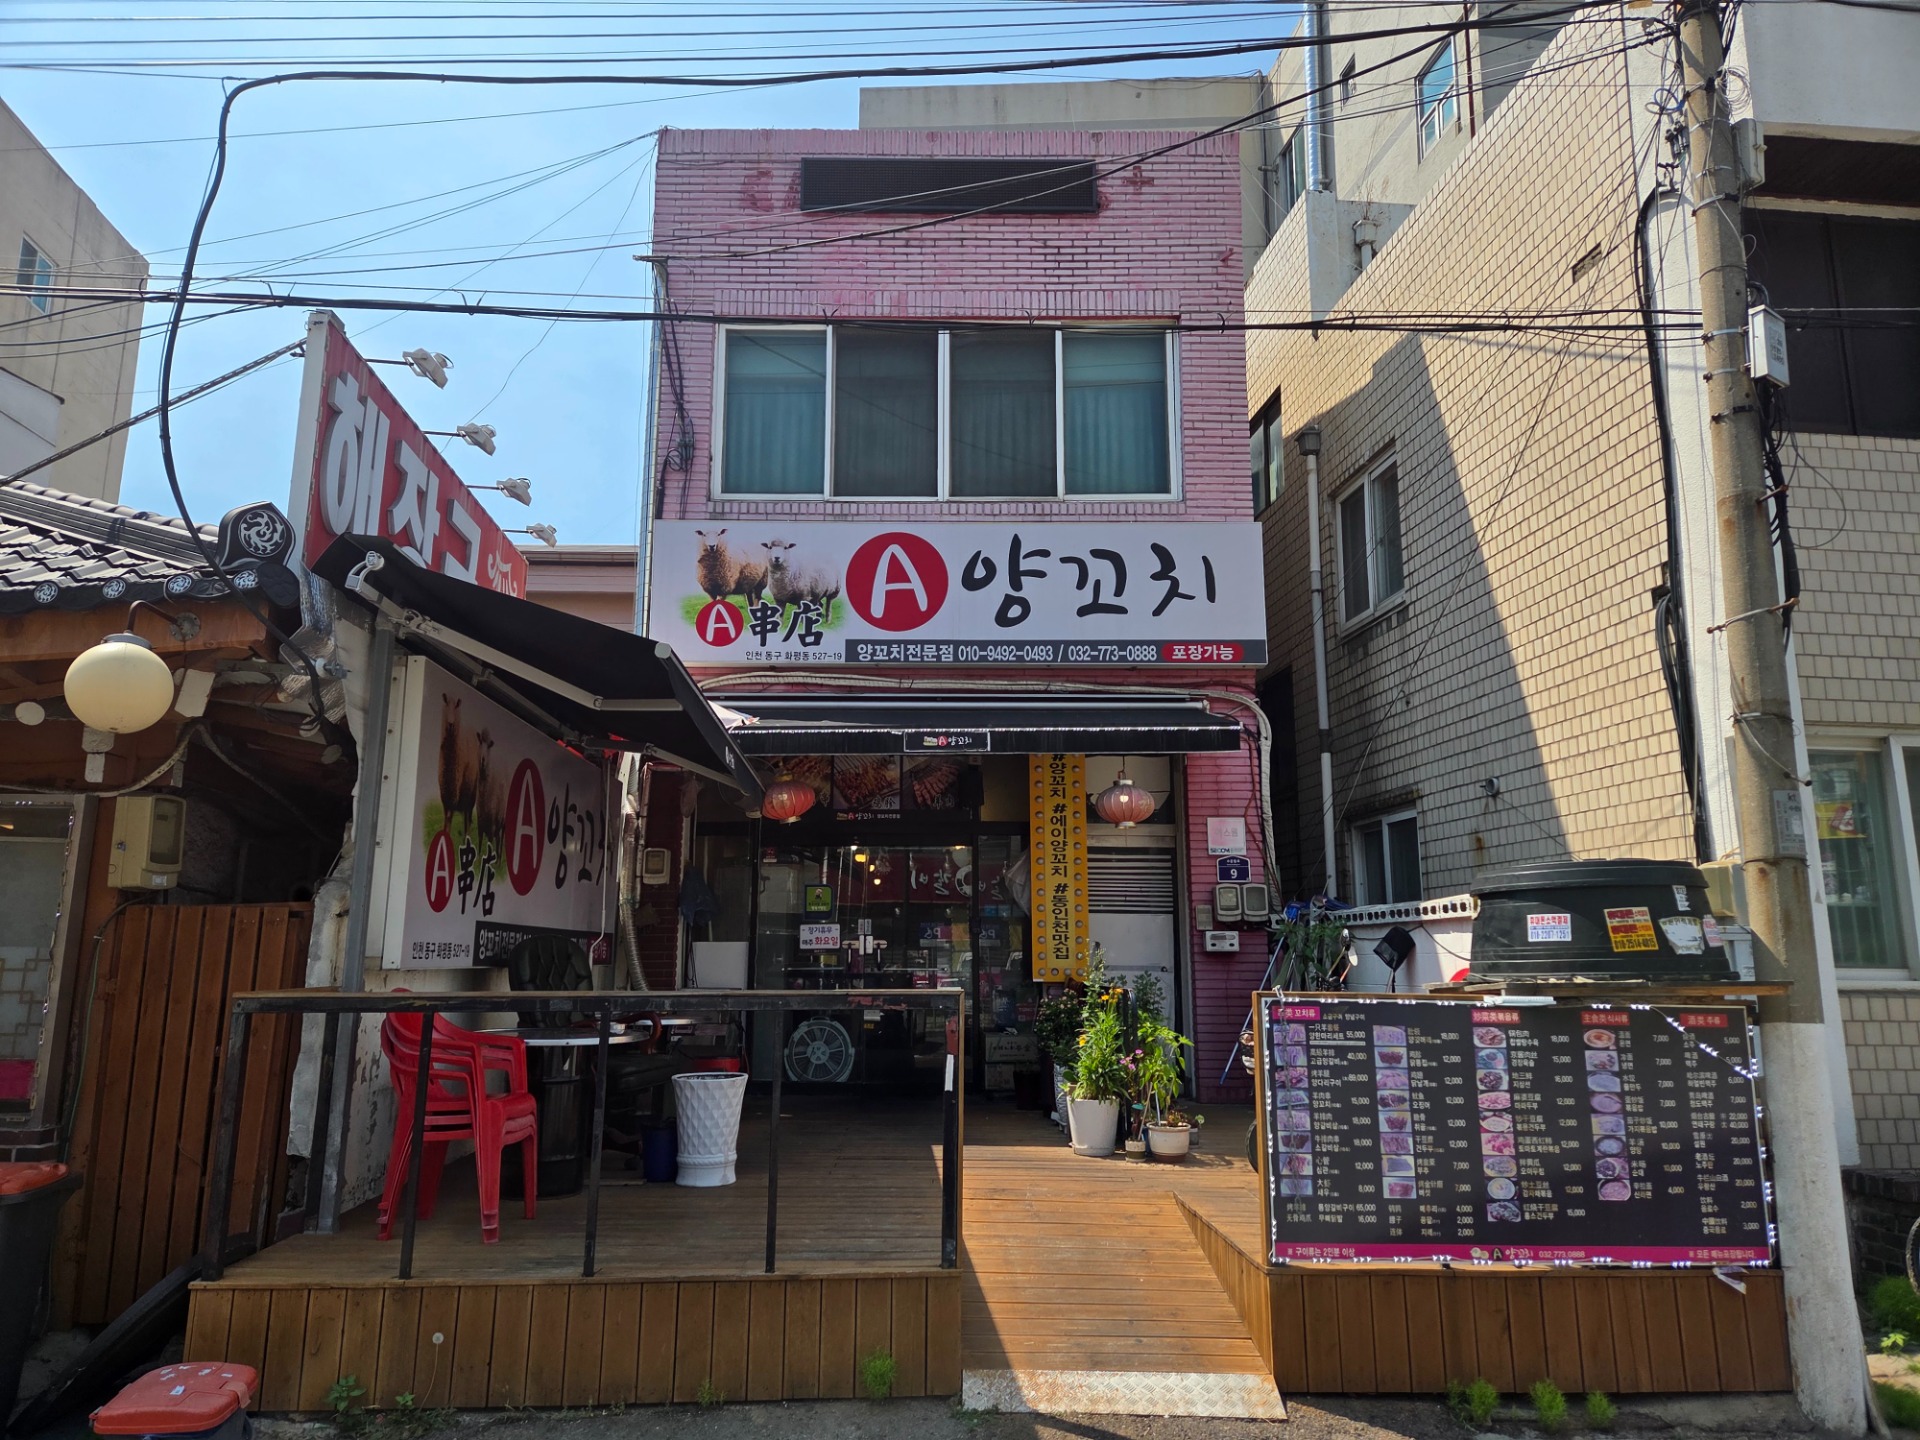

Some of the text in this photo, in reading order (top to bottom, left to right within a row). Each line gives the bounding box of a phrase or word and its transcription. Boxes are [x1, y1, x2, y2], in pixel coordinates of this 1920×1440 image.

[961, 533, 1216, 628] 양꼬치
[748, 600, 823, 648] 串店
[745, 650, 842, 660] 인천 동구 화평동 527-19
[857, 643, 954, 662] 양꼬치전문점
[958, 644, 1054, 661] 010-9492-0493
[1068, 645, 1157, 661] 032-773-0888
[1172, 645, 1234, 660] 포장가능
[948, 735, 972, 746] 양꼬치
[1050, 803, 1068, 878] #에이양꼬치
[458, 835, 497, 917] 串店
[1230, 868, 1238, 879] 9
[1051, 883, 1069, 960] #동인천맛집
[808, 926, 832, 935] 정기휴무
[815, 936, 838, 947] 화요일
[1346, 1031, 1366, 1039] 55,000
[1652, 1034, 1670, 1042] 7,000
[1442, 1055, 1461, 1063] 12,000
[1552, 1056, 1571, 1064] 15,000
[1655, 1058, 1672, 1066] 7,000
[1725, 1056, 1742, 1064] 5,000
[1444, 1077, 1463, 1085] 12,000
[1657, 1080, 1674, 1088] 7,000
[1727, 1076, 1744, 1084] 6,000
[1556, 1098, 1576, 1106] 12,000
[1659, 1099, 1676, 1107] 7,000
[1730, 1096, 1746, 1104] 7,000
[1413, 1101, 1430, 1110] 오징어
[1447, 1119, 1466, 1127] 12,000
[1558, 1119, 1578, 1127] 12,000
[1449, 1140, 1468, 1148] 12,000
[1561, 1140, 1580, 1148] 12,000
[1355, 1162, 1374, 1170] 12,000
[1453, 1162, 1470, 1170] 7,000
[1563, 1163, 1582, 1171] 12,000
[1358, 1185, 1375, 1193] 8,000
[1667, 1186, 1685, 1195] 4,000
[1456, 1205, 1473, 1213] 4,000
[1740, 1201, 1757, 1209] 2,000
[1456, 1216, 1474, 1225] 2,000
[1742, 1222, 1759, 1230] 3,000
[1457, 1228, 1474, 1237] 2,000
[1295, 1247, 1355, 1257] 구이류는 2인분 이상
[1505, 1247, 1533, 1260] 양꼬치
